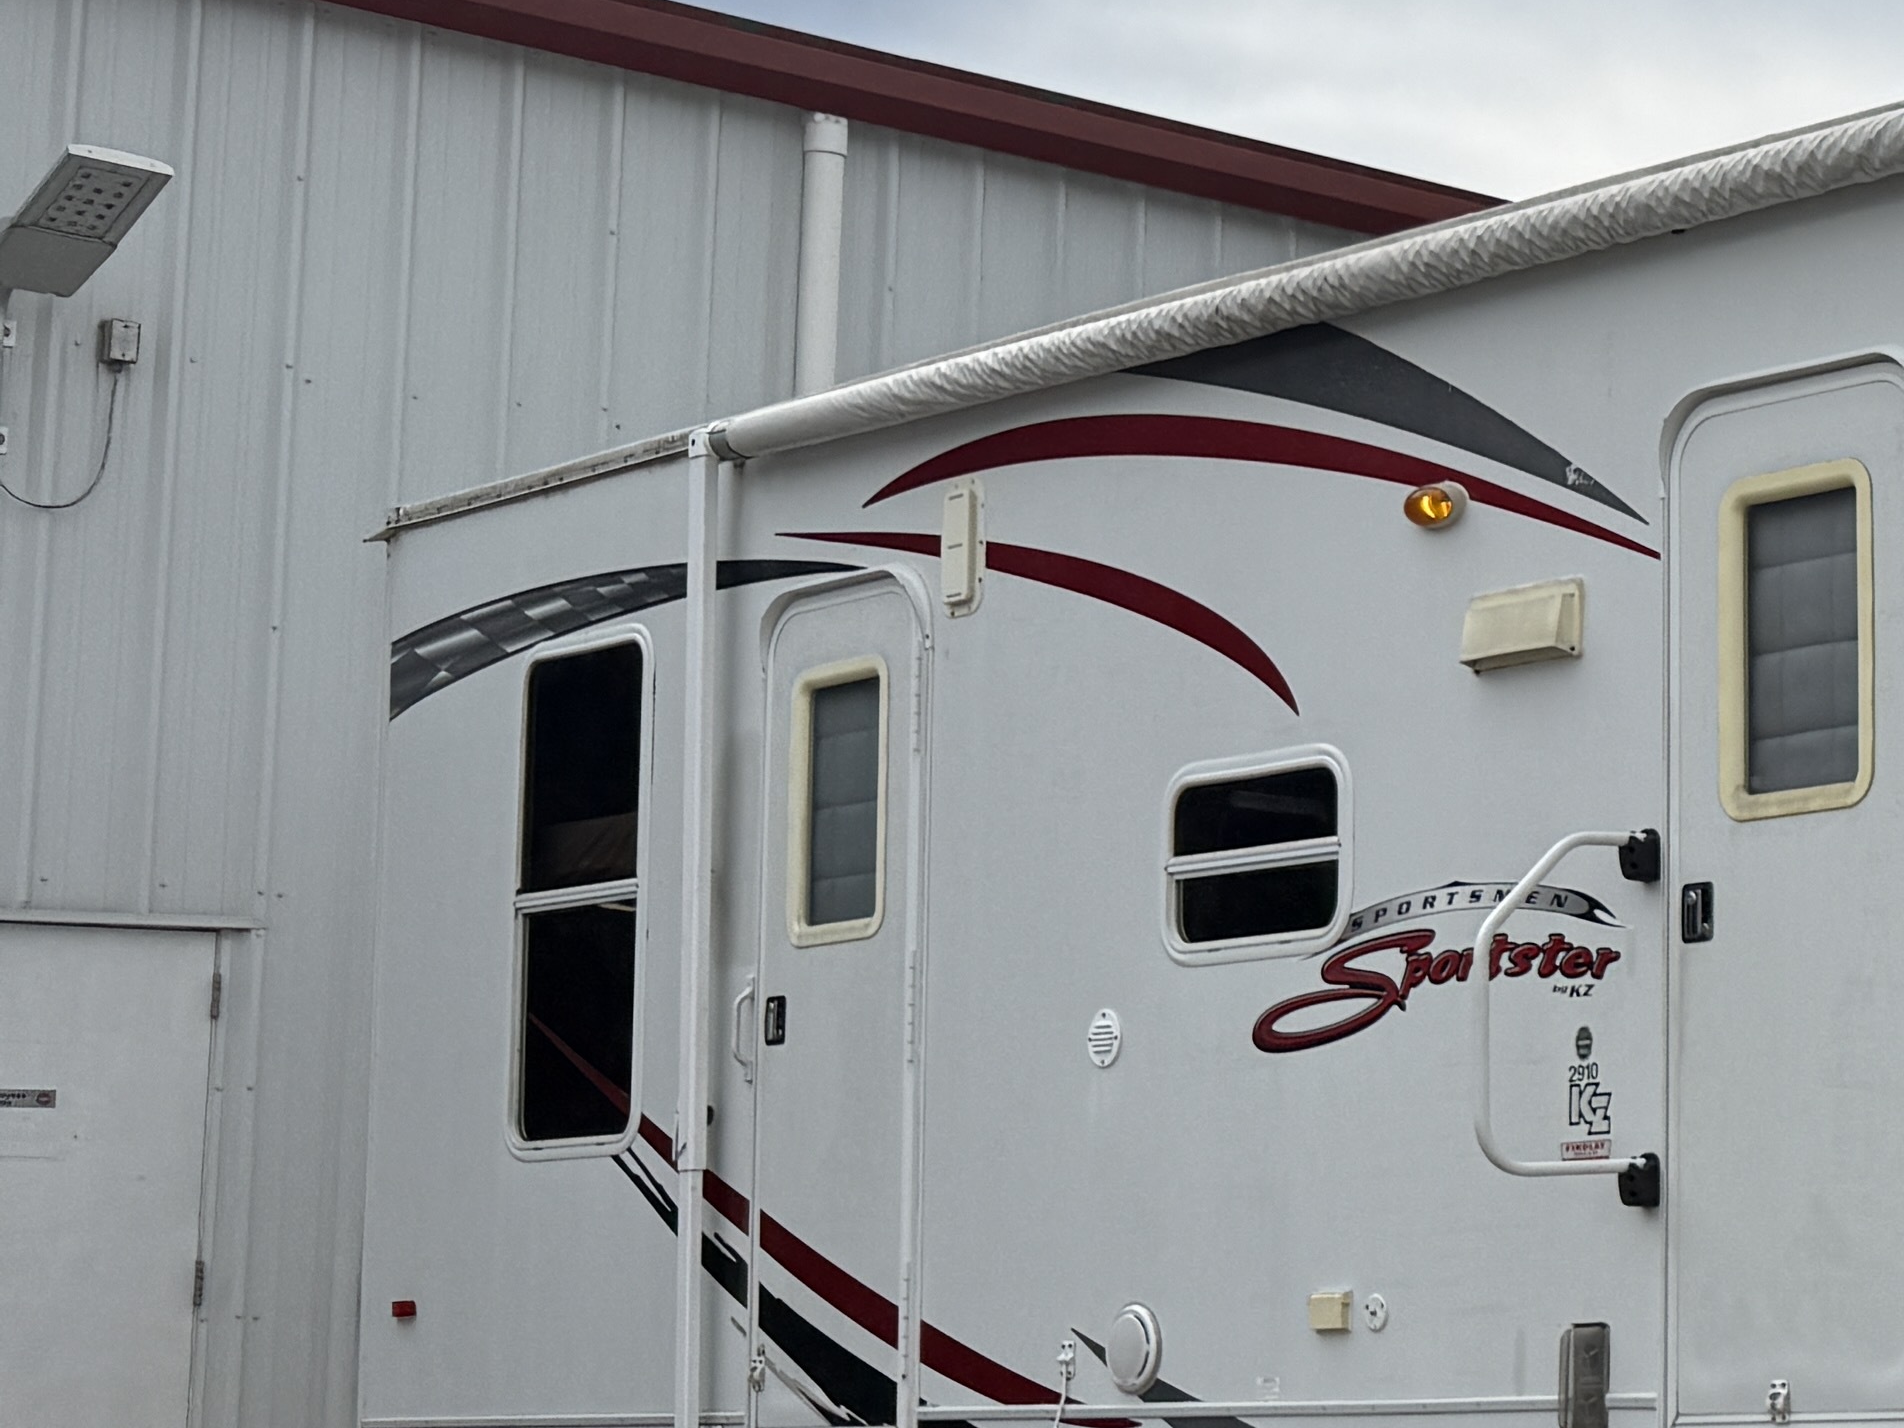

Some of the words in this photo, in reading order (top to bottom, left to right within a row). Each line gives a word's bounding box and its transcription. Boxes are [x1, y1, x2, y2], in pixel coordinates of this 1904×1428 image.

[1252, 927, 1622, 1054] Sportster
[1569, 983, 1595, 998] KZ
[1568, 1061, 1599, 1083] 2910
[1568, 1082, 1612, 1136] KZ
